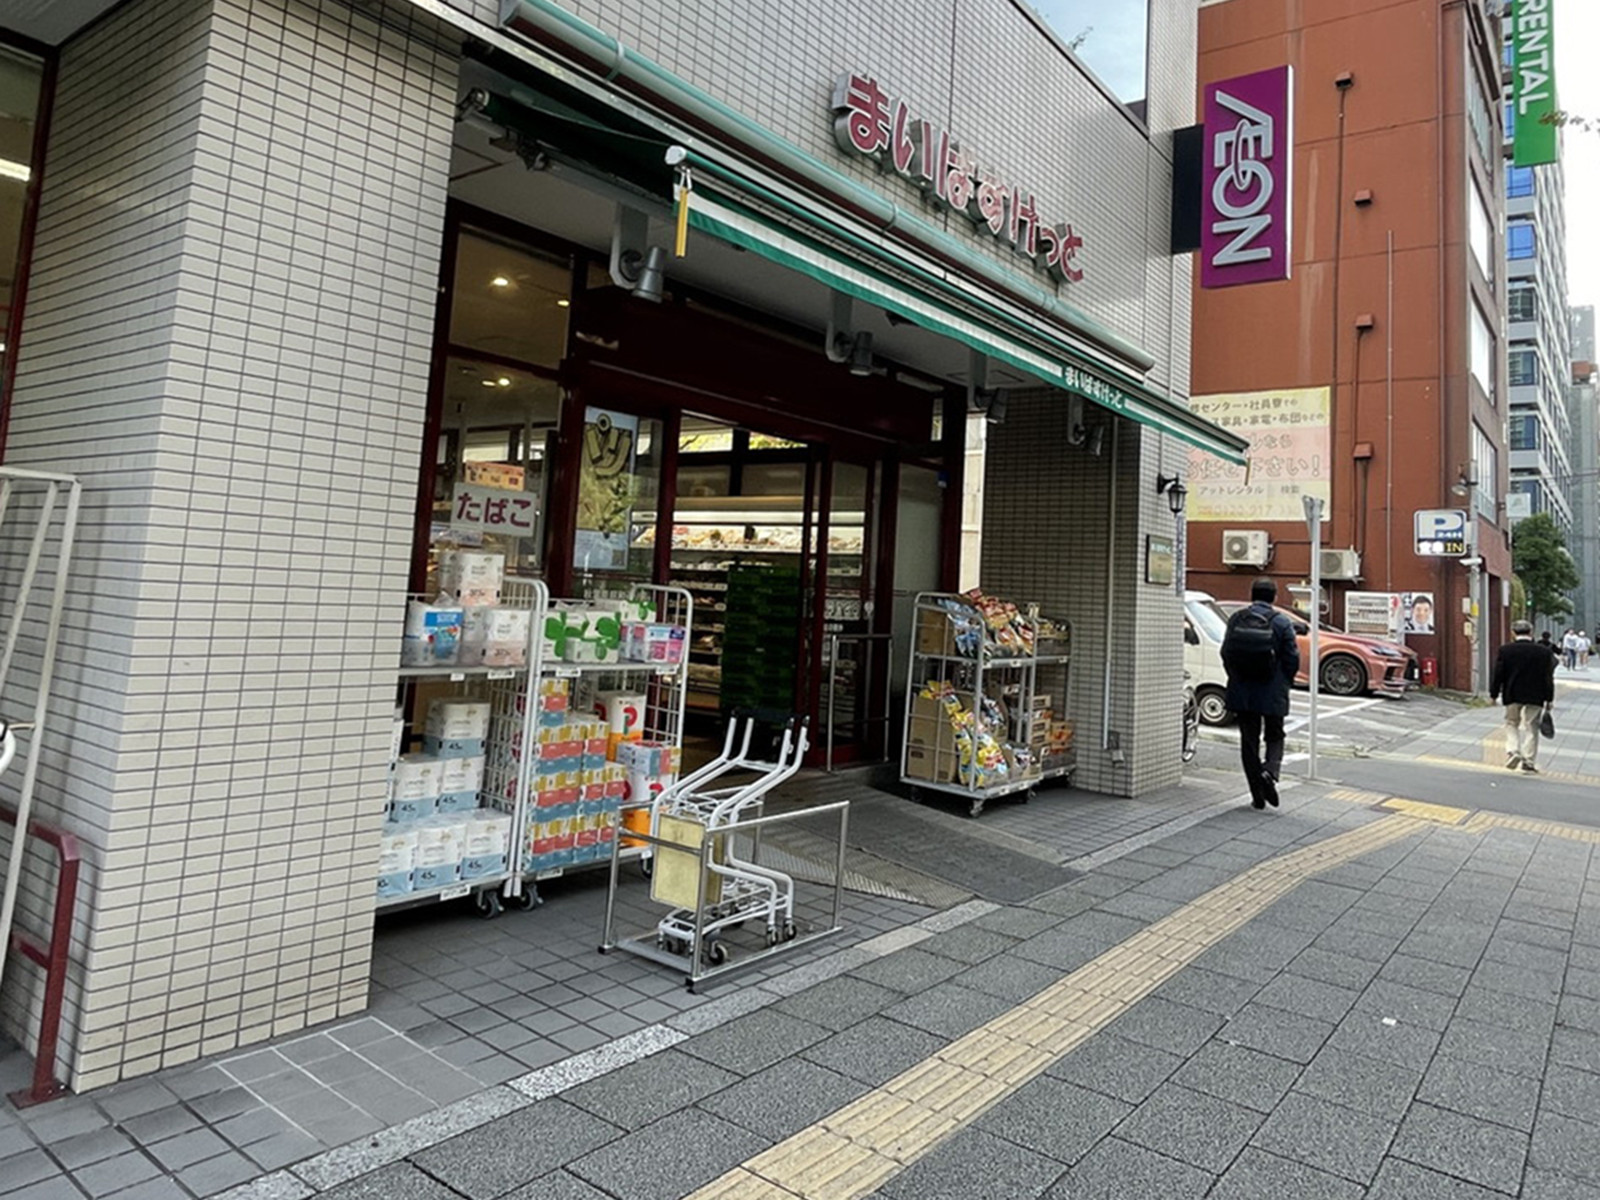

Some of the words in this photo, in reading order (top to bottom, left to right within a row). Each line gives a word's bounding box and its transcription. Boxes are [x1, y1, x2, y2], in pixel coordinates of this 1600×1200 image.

[845, 72, 1085, 284] まいばすけっと
[1212, 89, 1274, 266] AEON
[457, 492, 532, 528] たばこ
[1419, 513, 1463, 539] P
[1446, 542, 1464, 552] IN
